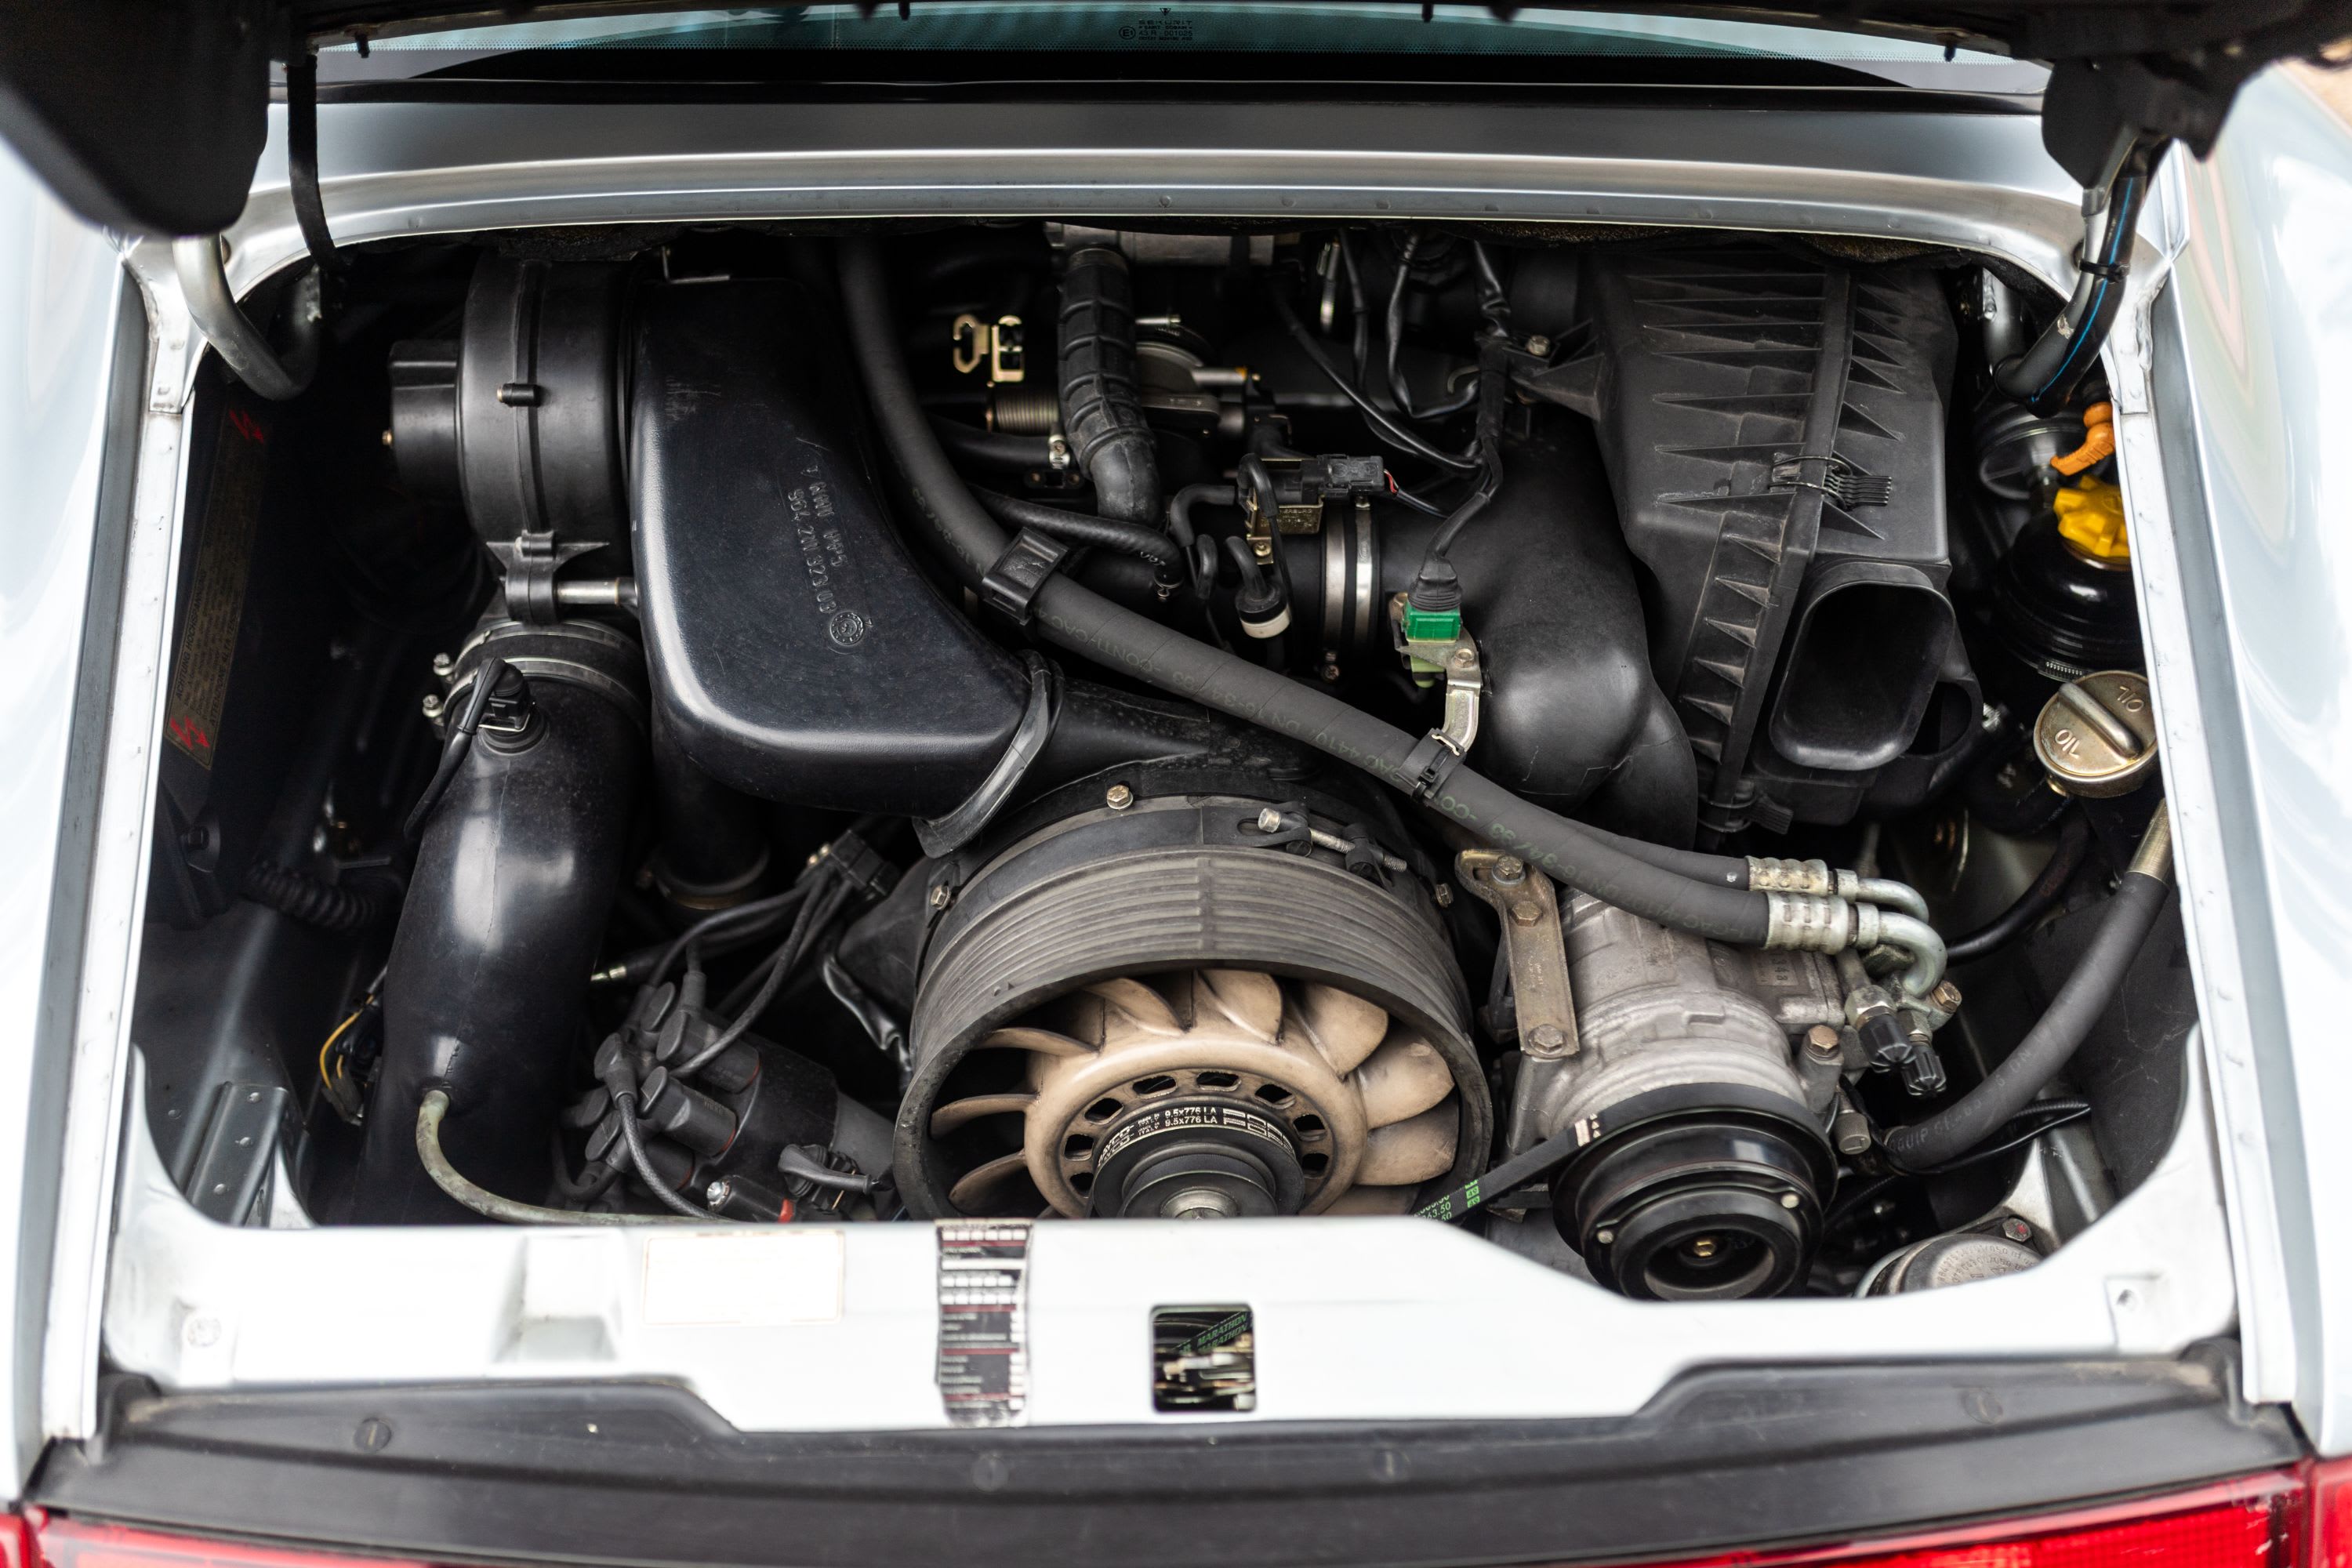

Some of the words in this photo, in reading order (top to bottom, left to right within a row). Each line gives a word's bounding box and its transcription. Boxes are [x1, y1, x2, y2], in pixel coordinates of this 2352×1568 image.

[174, 652, 191, 699] ACHTUNG
[2117, 686, 2145, 713] OIL
[2054, 728, 2081, 759] OIL
[1165, 1106, 1201, 1118] 9.5x776
[1165, 1116, 1202, 1127] 9.5x776
[1203, 1116, 1218, 1125] LA
[1196, 1314, 1248, 1345] MARATHON
